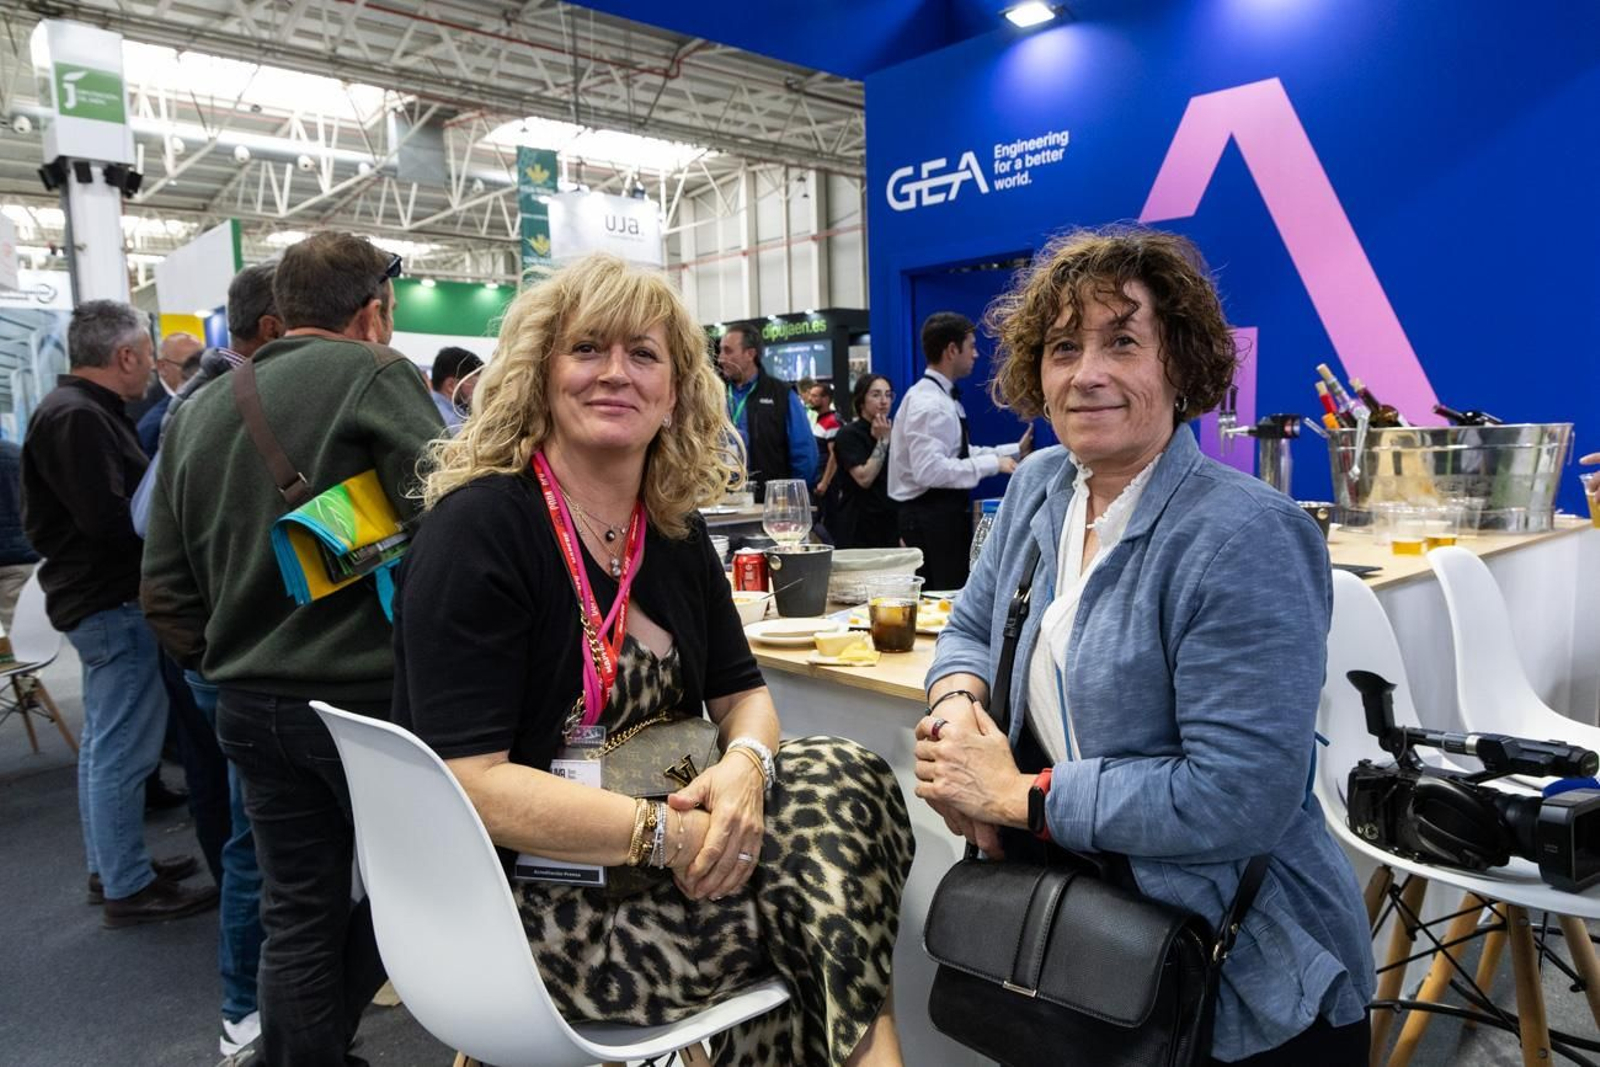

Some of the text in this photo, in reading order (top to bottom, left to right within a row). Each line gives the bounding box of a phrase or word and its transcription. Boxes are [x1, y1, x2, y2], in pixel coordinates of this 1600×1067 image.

[994, 130, 1069, 159] Engineering
[994, 148, 1065, 175] for a better
[886, 151, 990, 211] GEA
[994, 170, 1033, 191] world.
[762, 319, 827, 341] dipujaen.es
